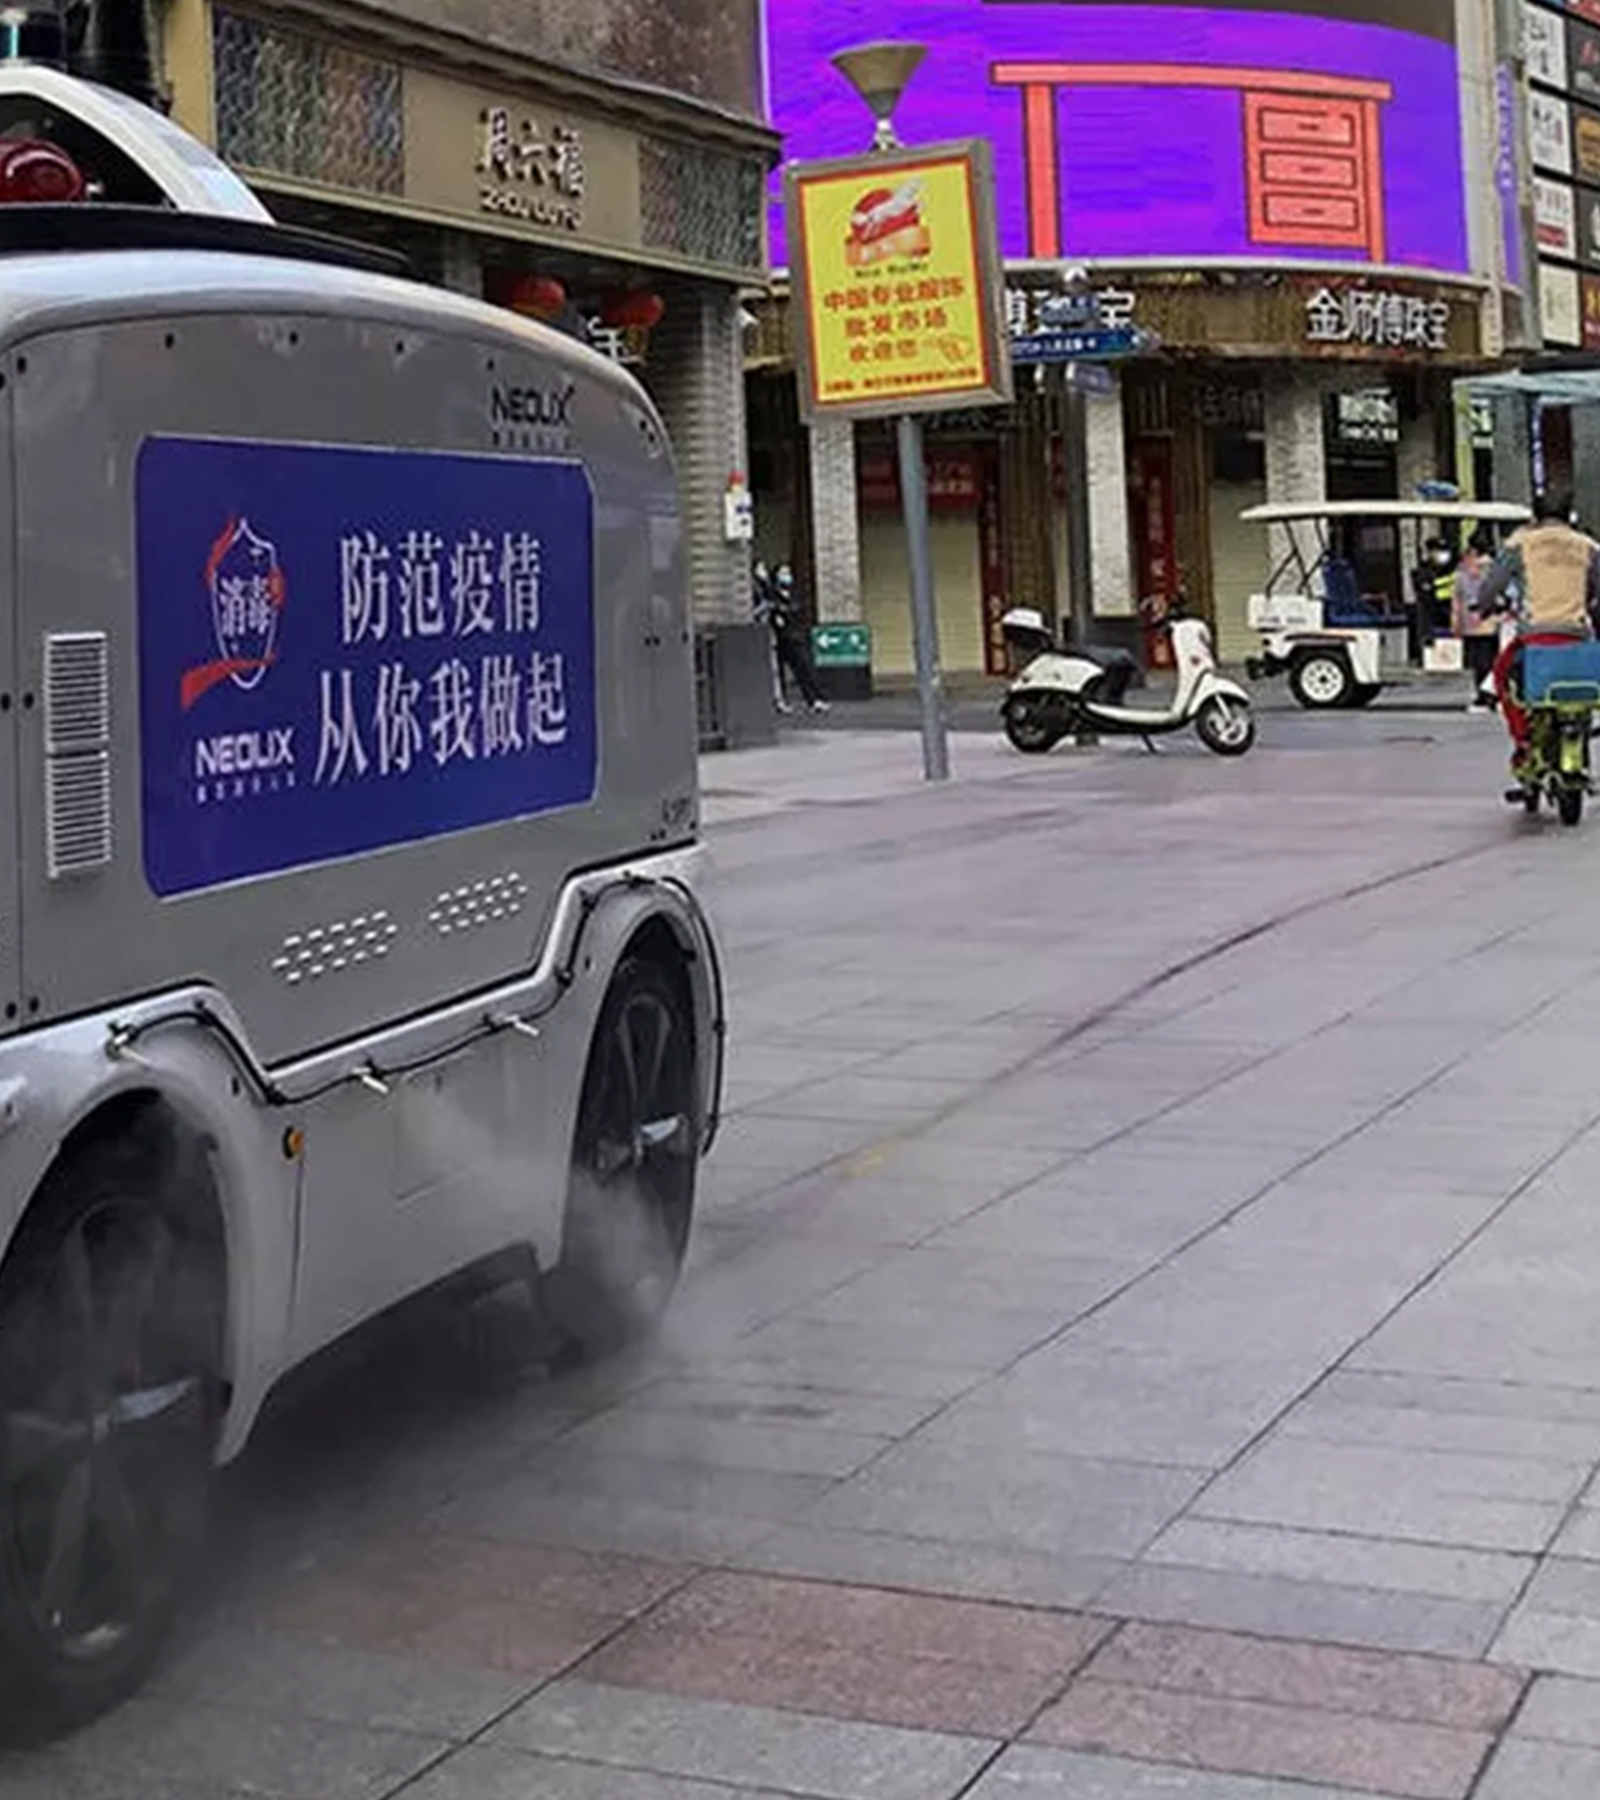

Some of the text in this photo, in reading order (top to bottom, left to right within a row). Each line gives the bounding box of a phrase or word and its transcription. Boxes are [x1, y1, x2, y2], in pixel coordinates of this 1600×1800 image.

[1305, 288, 1449, 348] 金师傅珠宝
[340, 529, 541, 645] 防范疫情
[196, 727, 294, 777] NEOLIX
[312, 651, 569, 786] 从你我做起
